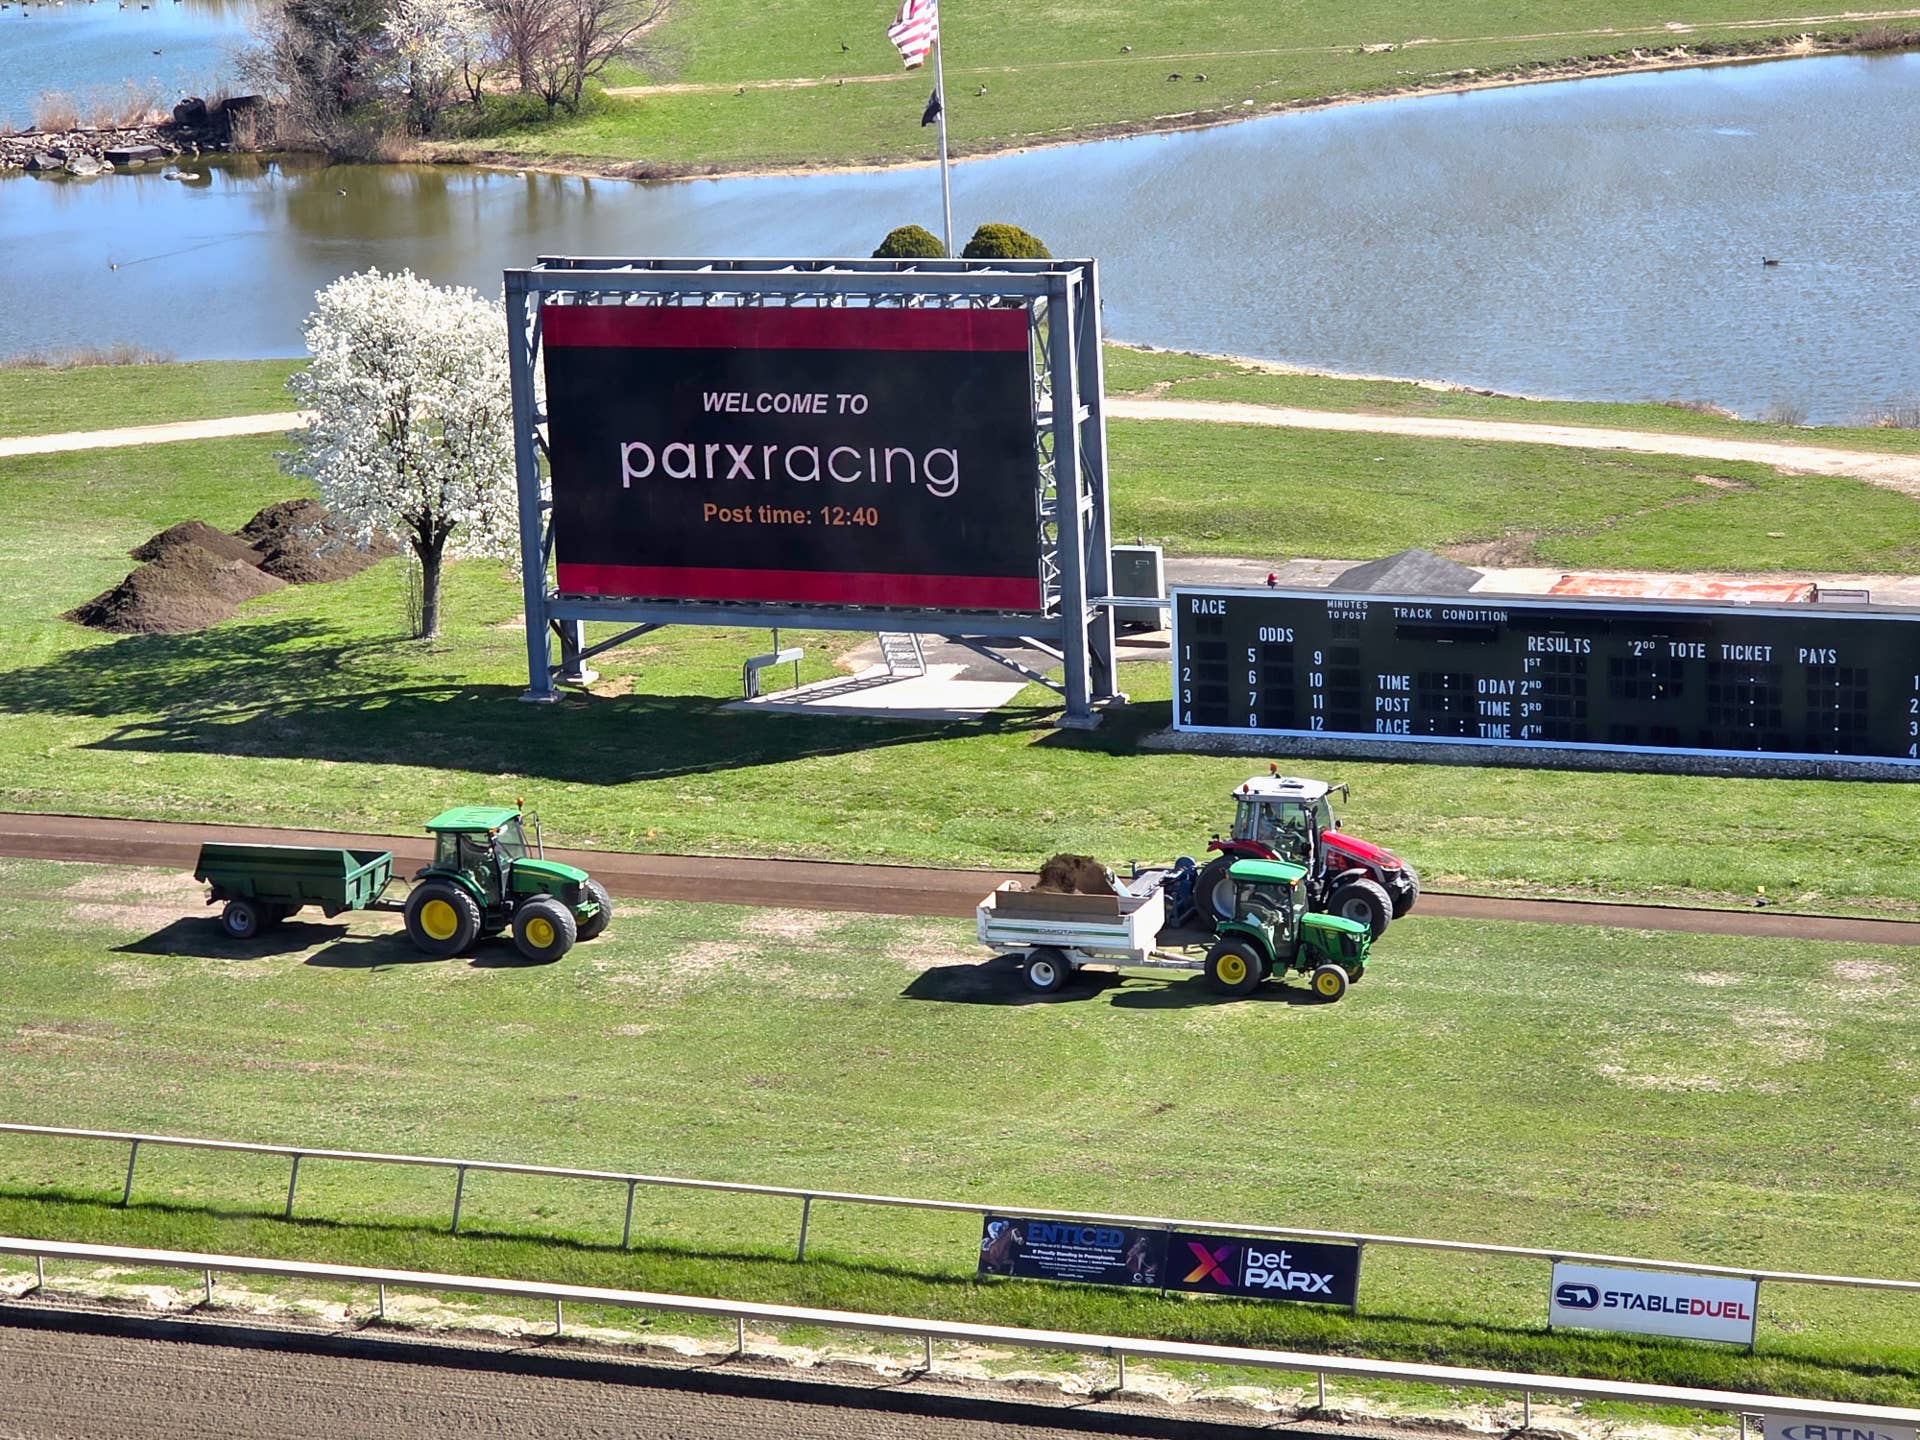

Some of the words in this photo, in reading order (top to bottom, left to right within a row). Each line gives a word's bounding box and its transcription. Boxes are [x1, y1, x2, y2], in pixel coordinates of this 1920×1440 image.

[703, 391, 829, 414] WELCOME
[836, 393, 869, 415] TO
[703, 503, 753, 523] Post
[758, 504, 812, 525] time:
[820, 506, 878, 526] 12:40
[1191, 598, 1227, 615] RACE
[1326, 600, 1369, 610] MINUTES
[1327, 610, 1340, 619] TO
[1342, 610, 1367, 621] POST
[1392, 607, 1433, 619] TRACK
[1442, 609, 1508, 622] CONDITION
[1259, 626, 1294, 643] ODDS
[1185, 645, 1191, 661] 1
[1527, 636, 1591, 654] RESULTS
[1247, 647, 1256, 663] 5
[1313, 650, 1322, 665] 9
[1668, 642, 1706, 659] TOTE
[1720, 644, 1772, 662] TICKET
[1799, 648, 1837, 665] PAYS
[1183, 667, 1191, 682] 2
[1248, 669, 1257, 685] 6
[1309, 672, 1323, 688] 10
[1377, 674, 1411, 691] TIME
[1914, 674, 1919, 691] 1
[1183, 688, 1192, 704] 3
[1520, 680, 1542, 696] 2ND
[1248, 691, 1257, 707] 7
[1312, 694, 1324, 710] 11
[1375, 696, 1410, 713] POST
[1478, 700, 1511, 717] TIME
[1909, 698, 1919, 714] 2
[1183, 710, 1192, 725] 4
[1520, 702, 1542, 718] 3RD
[1249, 713, 1258, 728] 8
[1310, 715, 1324, 731] 12
[1375, 718, 1411, 734] RACE
[1478, 722, 1512, 739] TIME
[1909, 720, 1918, 736] 3
[1520, 724, 1542, 740] 4TH
[1908, 743, 1918, 758] 4
[1027, 1223, 1125, 1248] ENTICED
[1246, 1247, 1293, 1270] bet
[1244, 1268, 1335, 1295] PARX
[1603, 1291, 1750, 1320] STABLEDUEL
